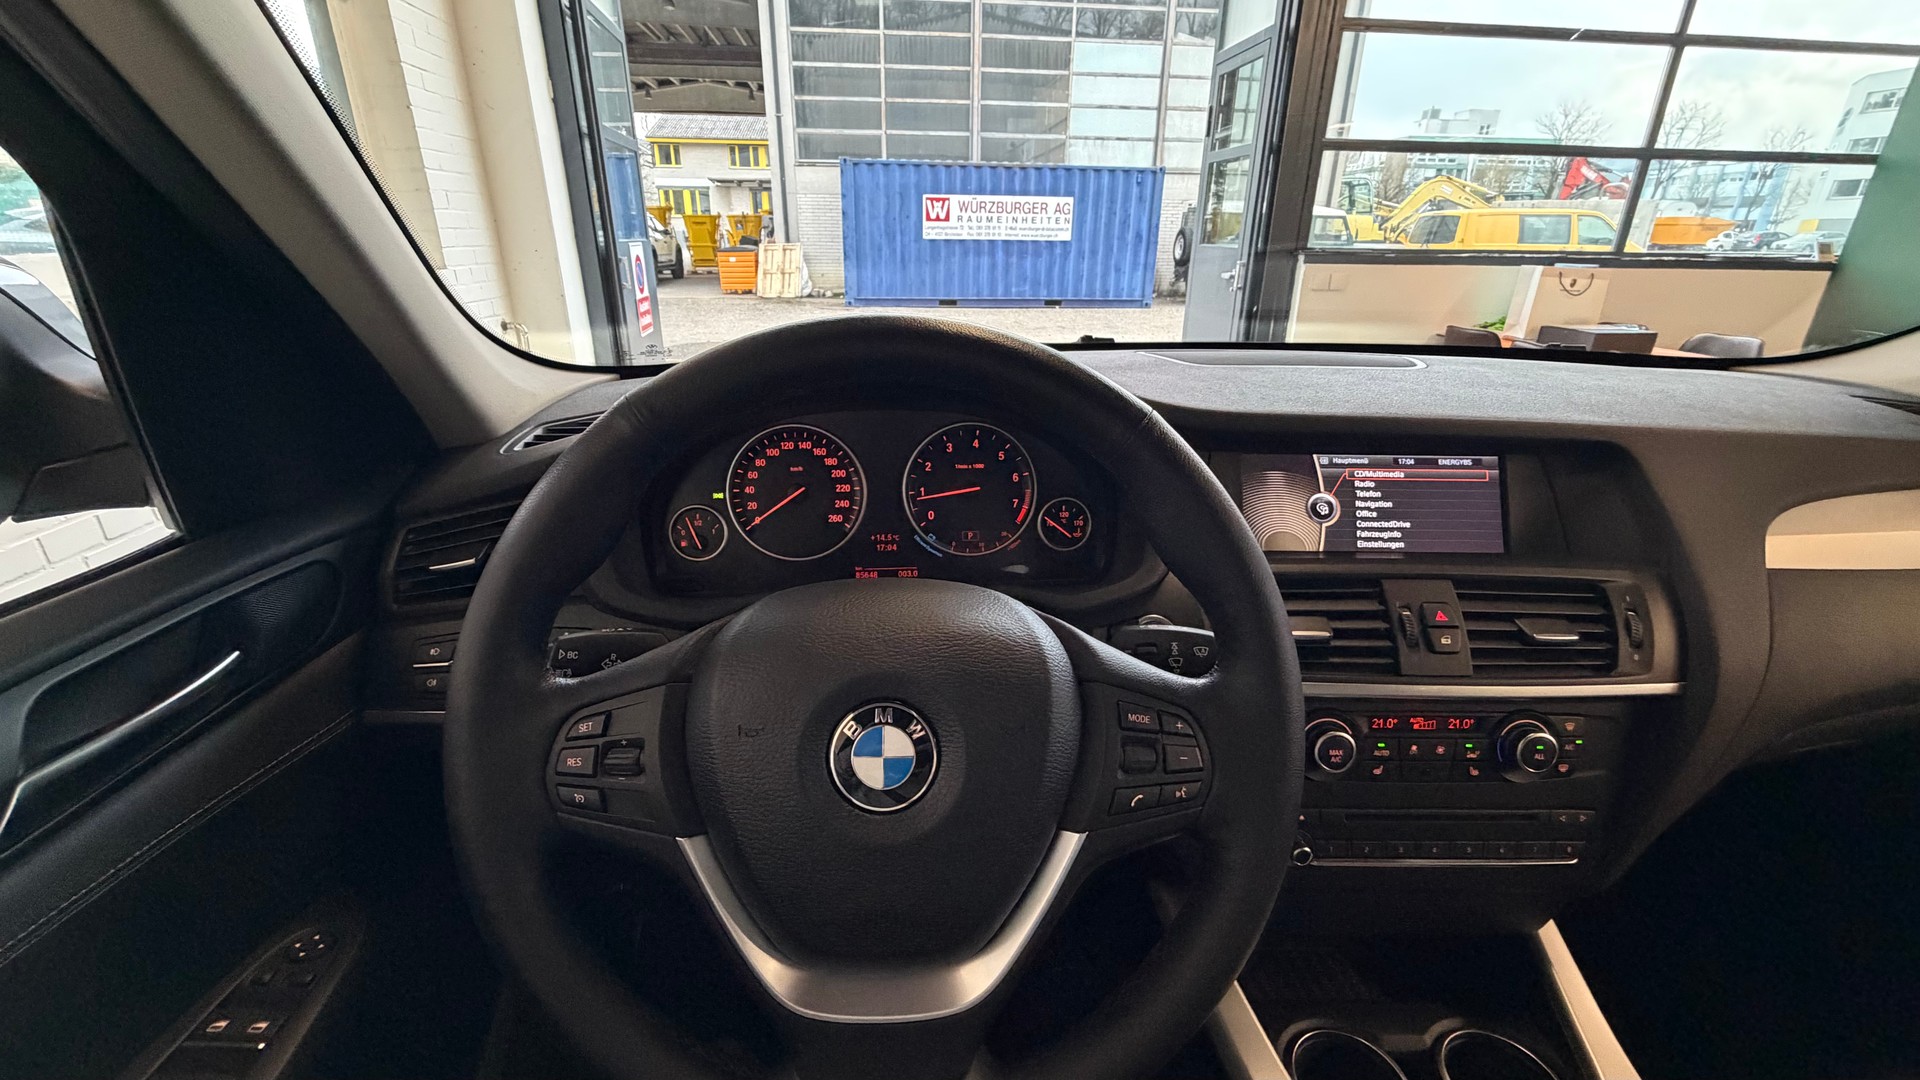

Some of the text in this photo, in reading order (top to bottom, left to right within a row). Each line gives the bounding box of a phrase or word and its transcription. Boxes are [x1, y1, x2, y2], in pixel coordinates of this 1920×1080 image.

[958, 198, 1070, 215] WÜRZBURGER AG
[958, 216, 1070, 224] RAUMEINHEITEN
[946, 443, 952, 452] 3
[972, 438, 979, 448] 4
[998, 452, 1005, 460] 5
[1333, 457, 1368, 465] Hauptmenü
[925, 462, 932, 471] 2
[1013, 473, 1019, 482] 6
[920, 487, 925, 496] 1
[1013, 499, 1018, 508] 7
[1355, 501, 1392, 509] Navigation
[928, 511, 934, 520] 0
[1357, 541, 1404, 549] Einstellungen
[1128, 713, 1150, 723] MODE
[579, 722, 593, 732] SET
[843, 708, 926, 740] BMW
[567, 758, 582, 766] RES
